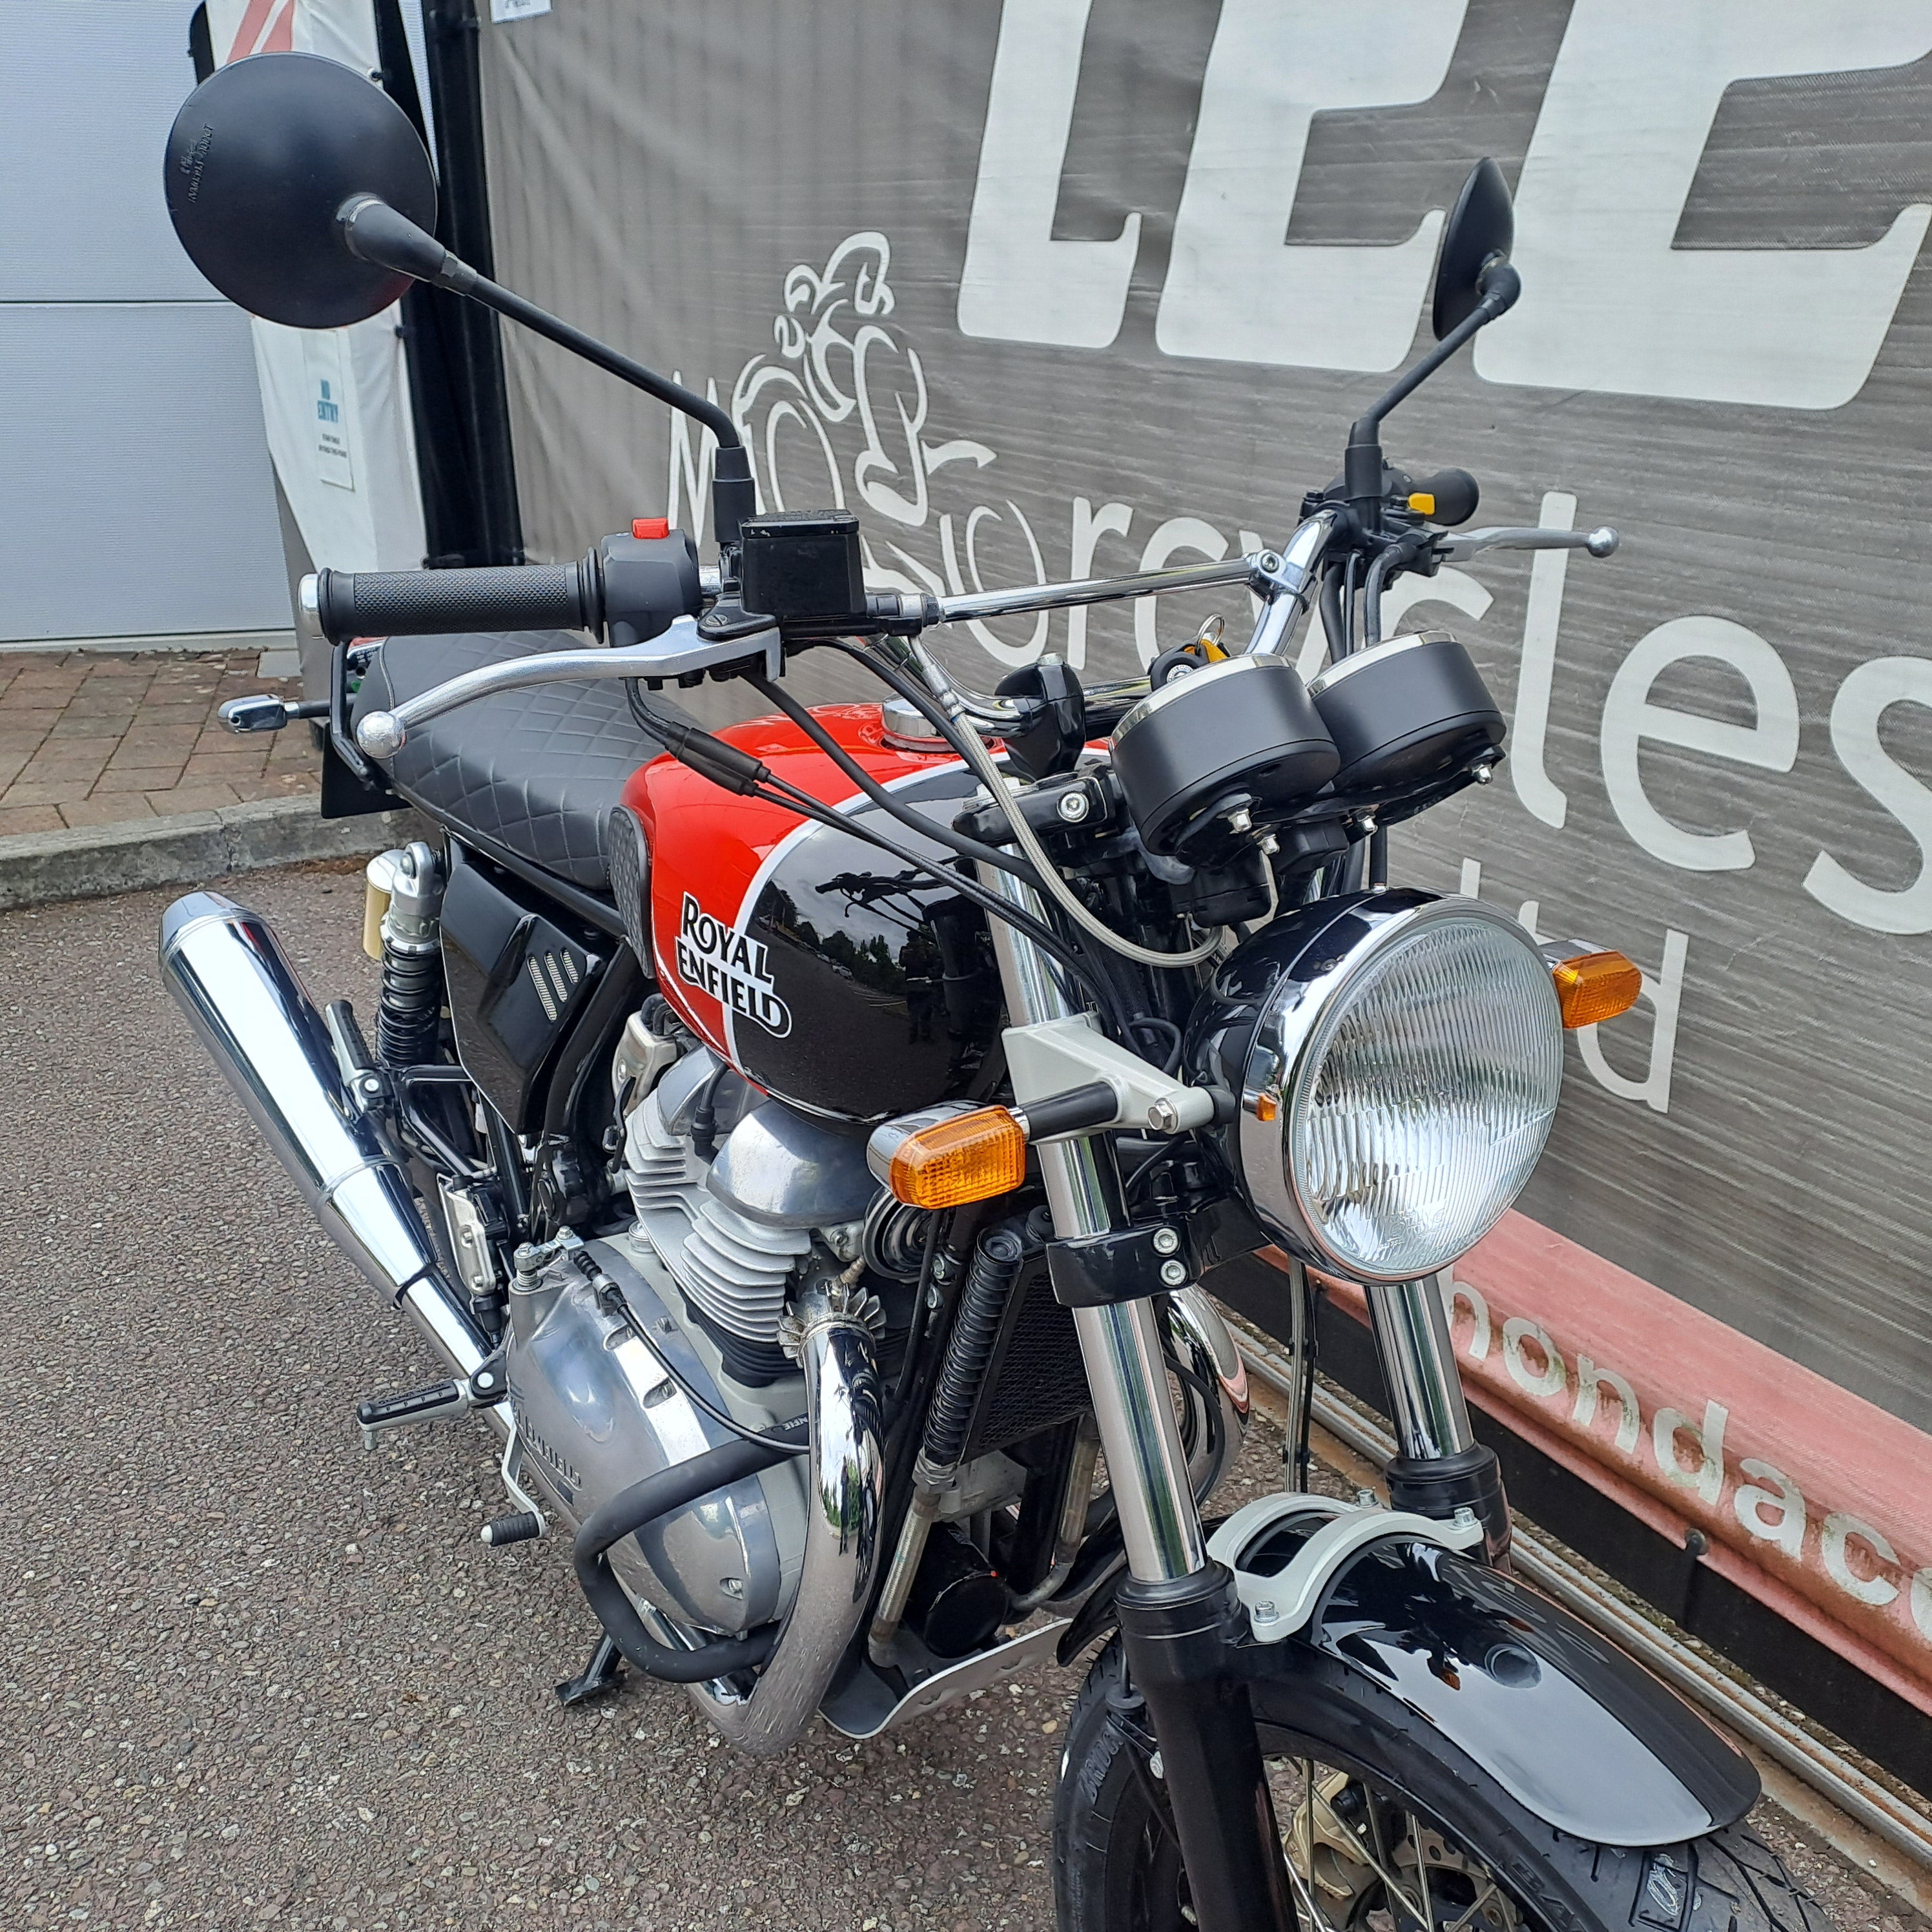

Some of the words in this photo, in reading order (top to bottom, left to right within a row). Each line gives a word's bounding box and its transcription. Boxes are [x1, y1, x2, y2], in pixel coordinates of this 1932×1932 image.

[682, 892, 774, 983] ROYAL
[675, 940, 792, 1038] ENFIELD
[1437, 1264, 1932, 1641] hondac
